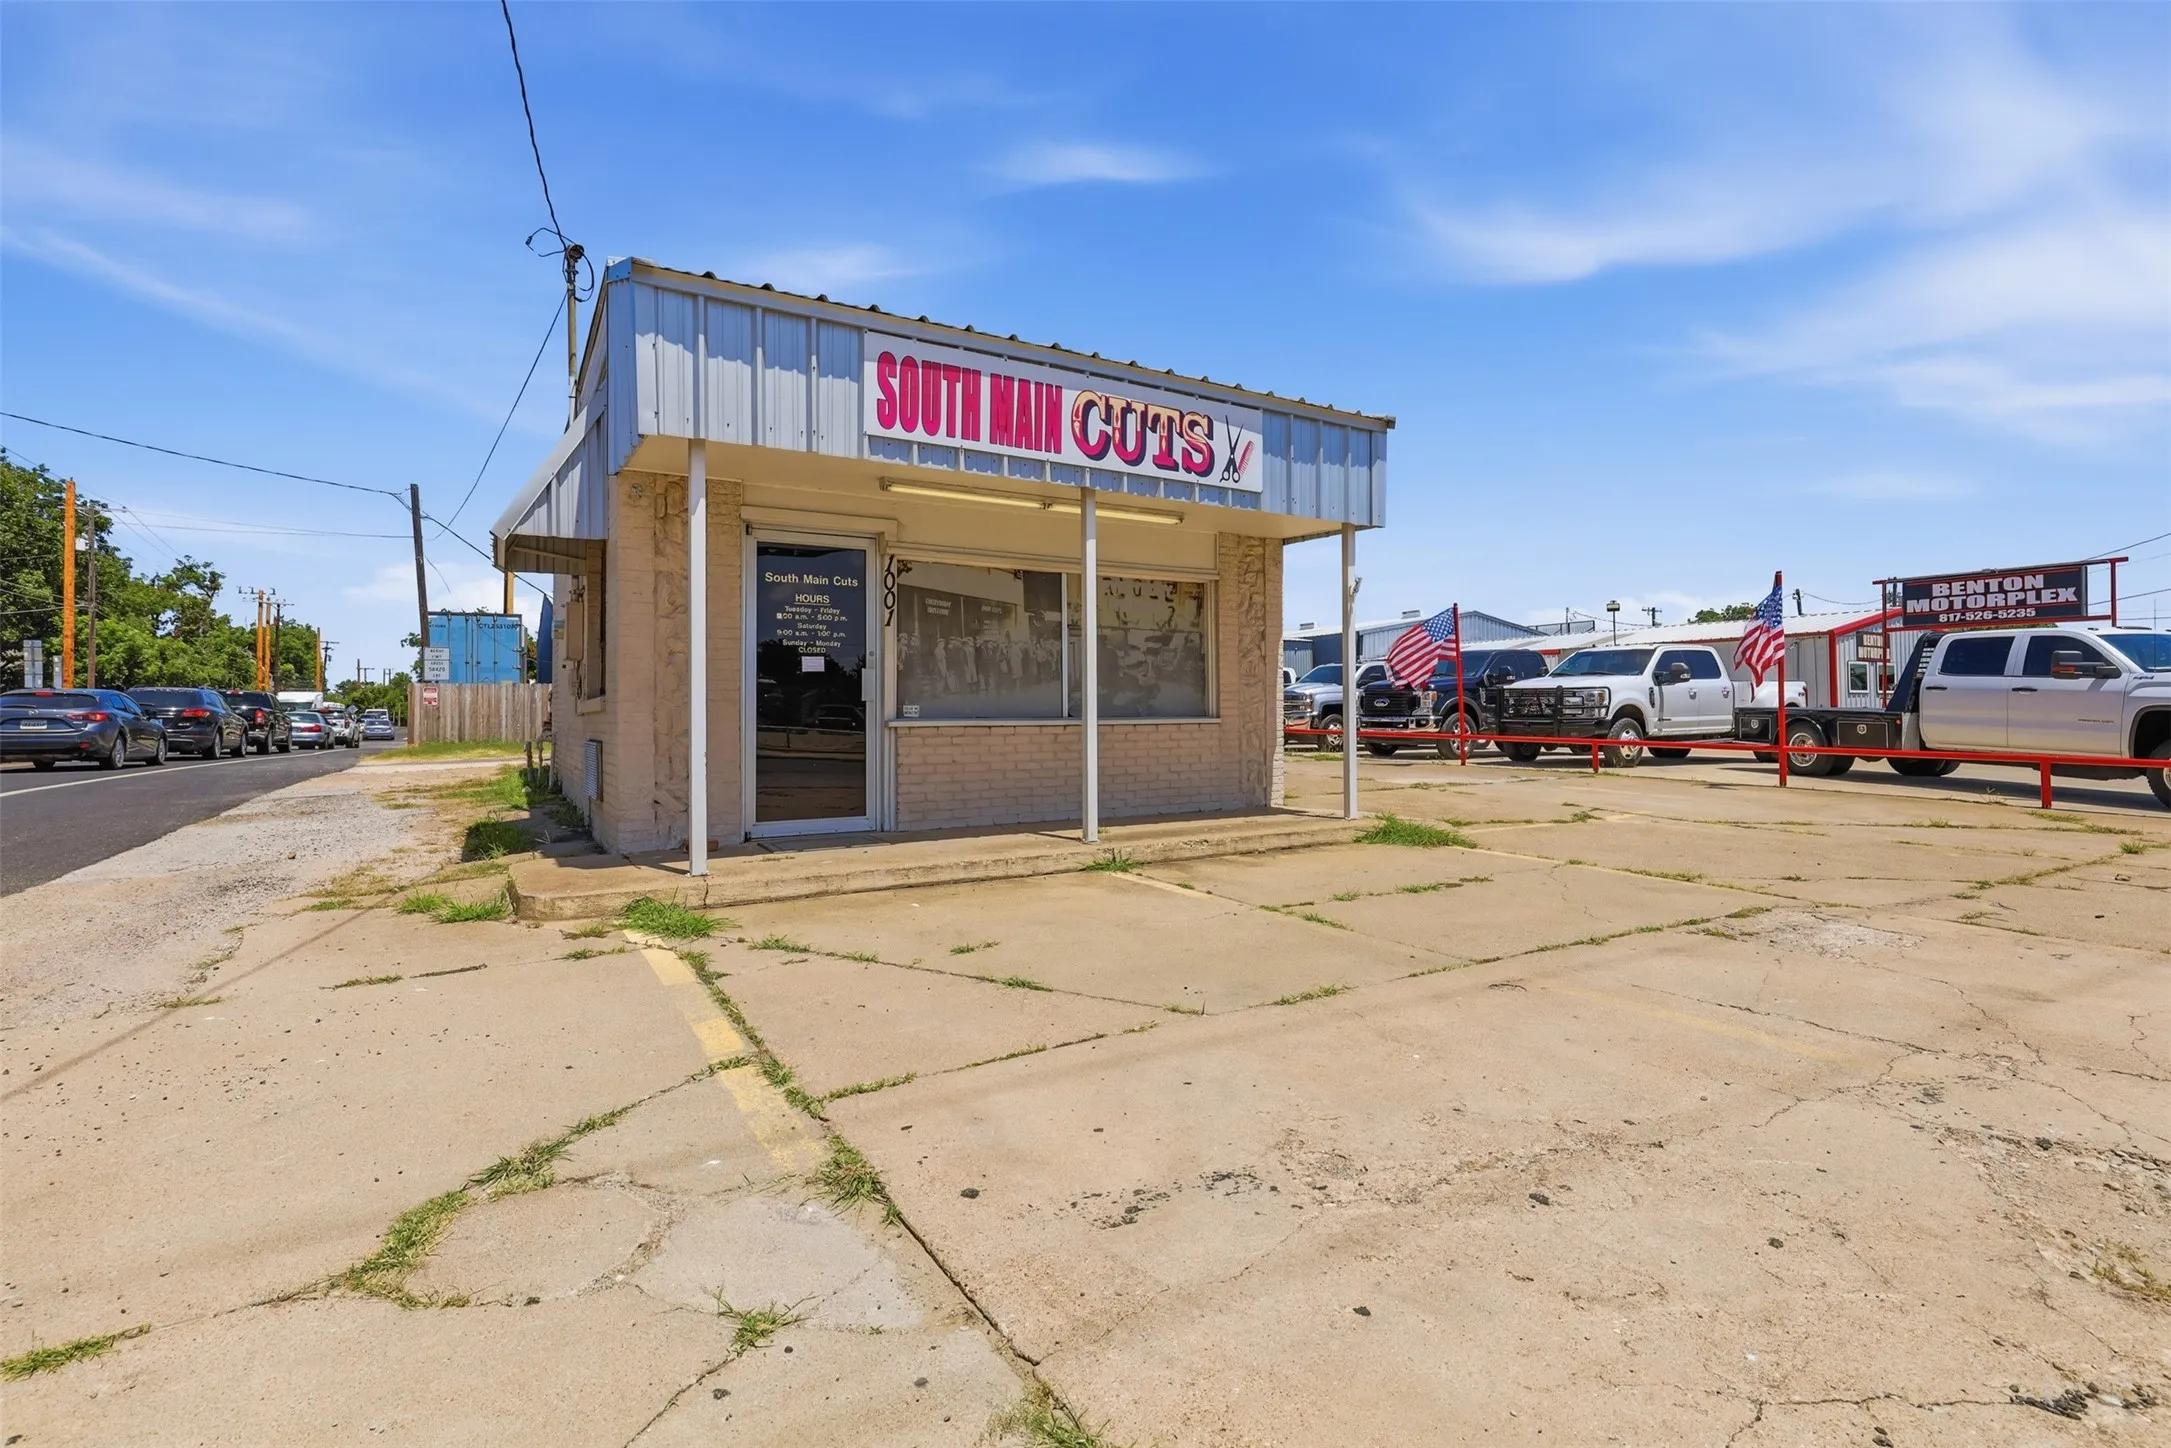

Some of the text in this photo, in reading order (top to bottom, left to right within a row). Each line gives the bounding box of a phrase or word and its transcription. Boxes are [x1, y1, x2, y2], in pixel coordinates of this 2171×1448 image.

[877, 351, 1215, 478] SOUTH MAIN CUTS
[765, 572, 858, 586] South Main Cuts
[1932, 574, 2044, 597] BENTON
[884, 553, 896, 626] 1001
[795, 594, 830, 603] HOURS
[1906, 586, 2078, 613] MOTORPLEX
[1939, 607, 2036, 623] 817-526-5235
[797, 622, 827, 630] Saturday
[782, 639, 807, 647] Sunday
